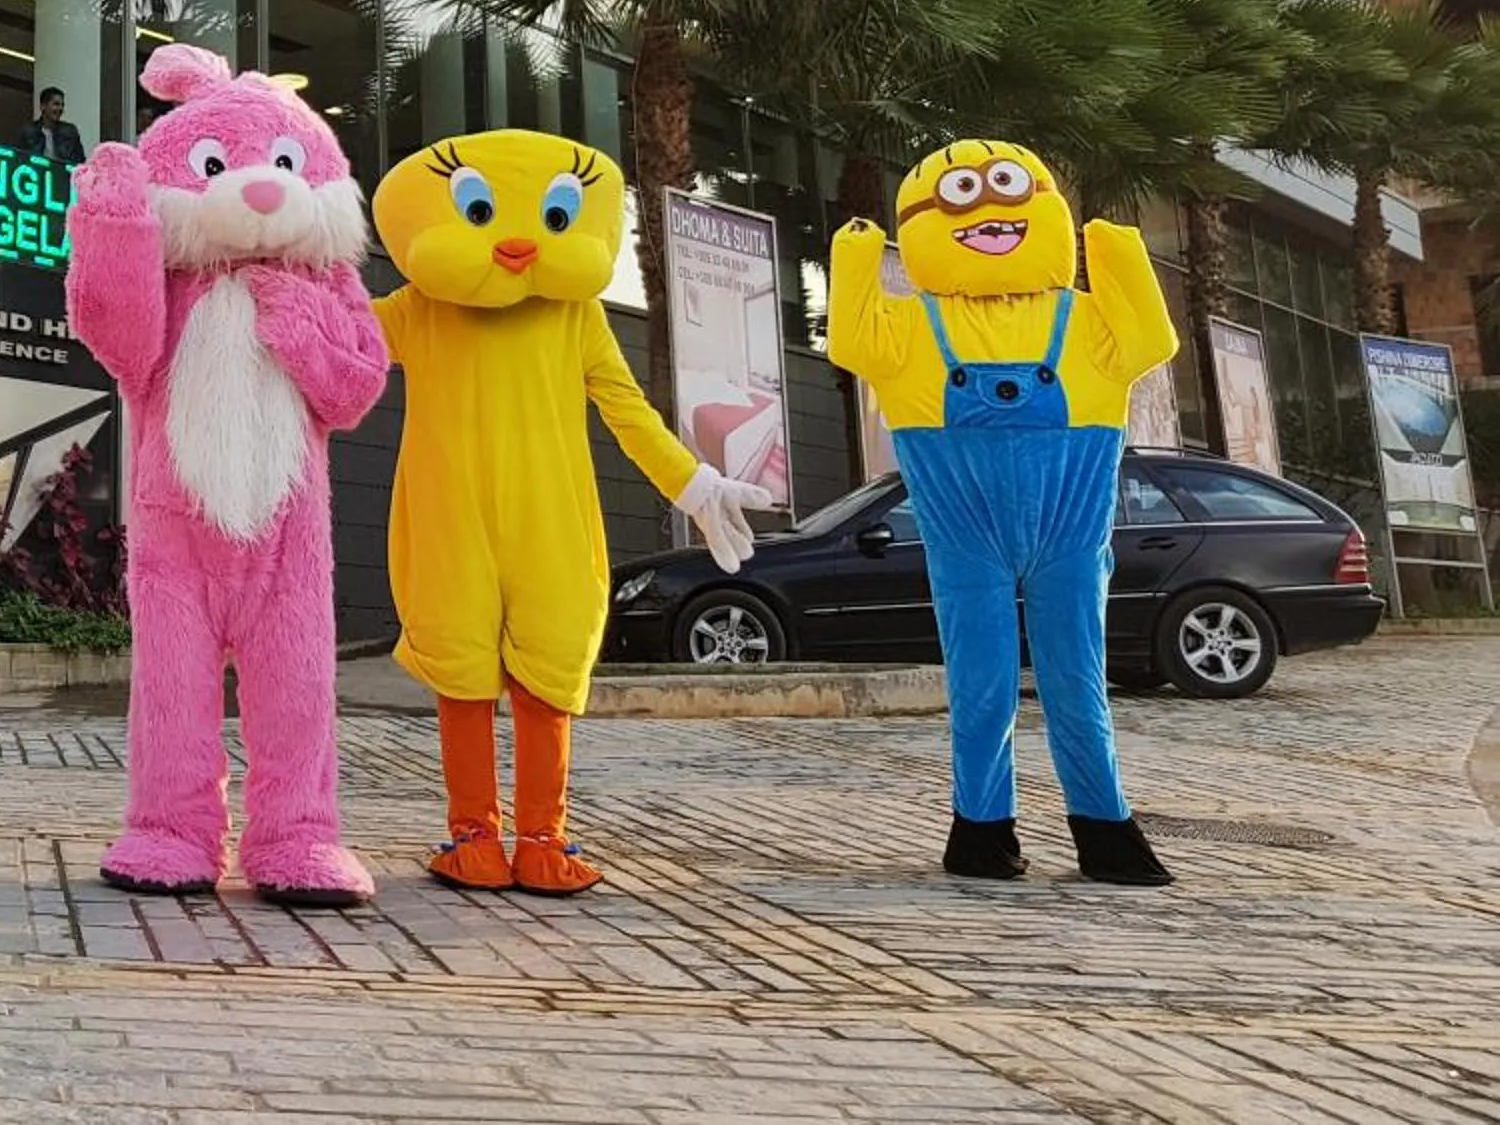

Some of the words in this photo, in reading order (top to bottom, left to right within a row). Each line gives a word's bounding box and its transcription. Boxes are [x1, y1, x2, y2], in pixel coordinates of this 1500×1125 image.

[672, 207, 720, 244] DHOMA
[722, 221, 731, 246] &
[734, 225, 769, 257] SUITA
